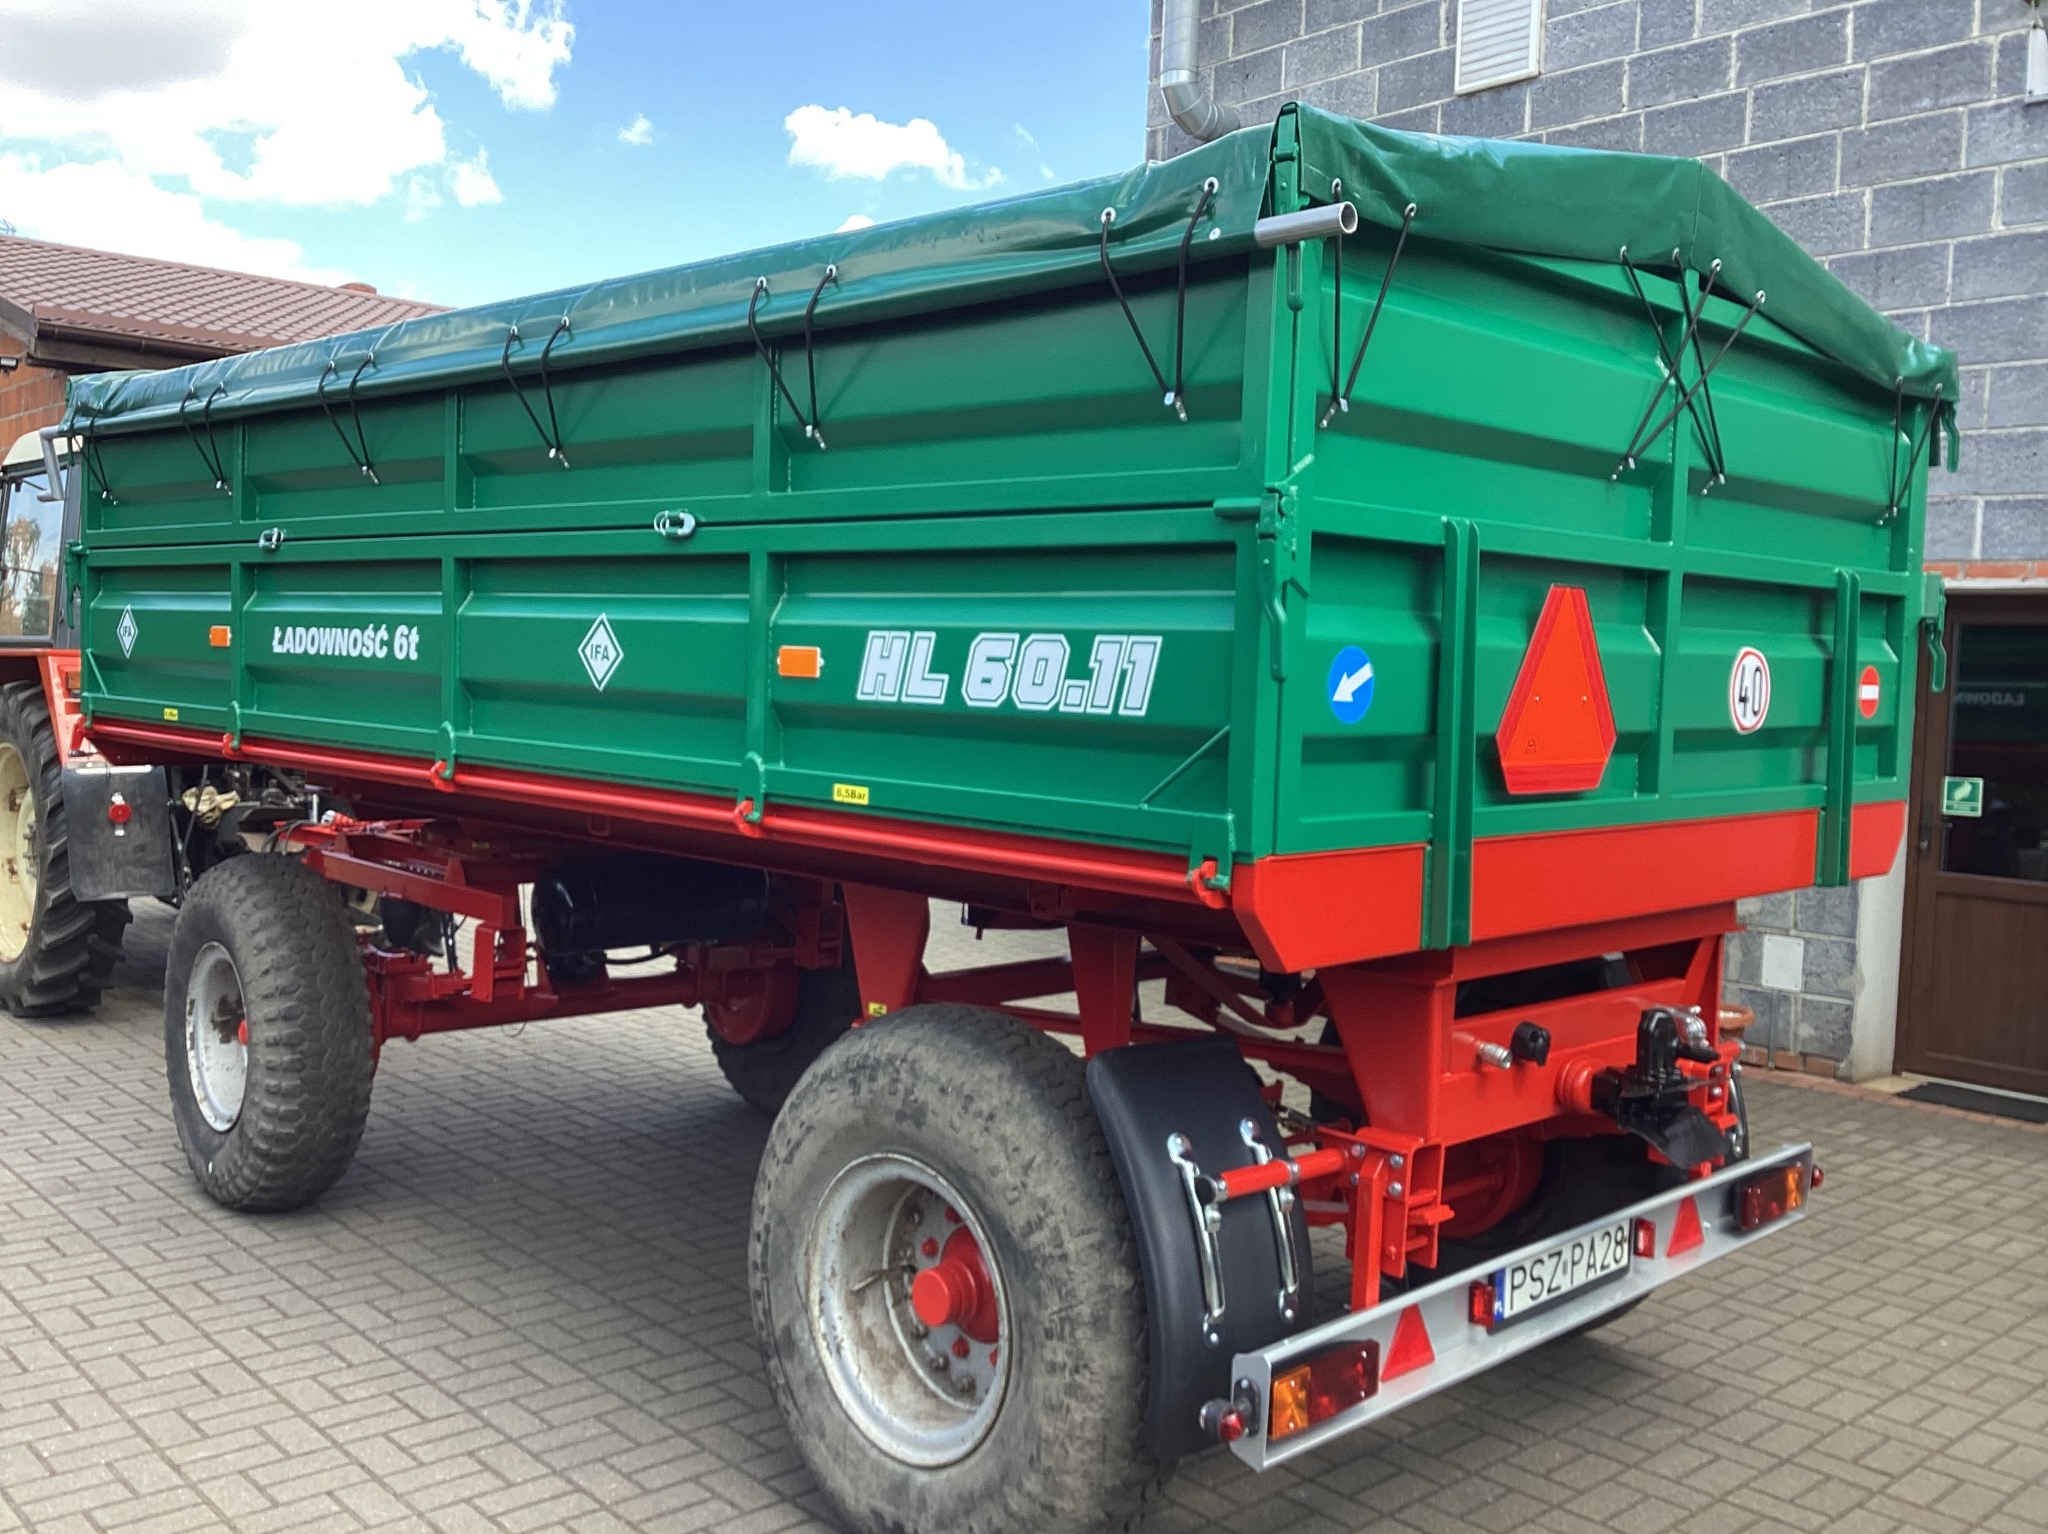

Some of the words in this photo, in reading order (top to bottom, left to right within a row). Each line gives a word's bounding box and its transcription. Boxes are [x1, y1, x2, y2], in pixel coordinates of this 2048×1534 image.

[122, 625, 132, 637] IFA
[272, 623, 389, 659] ŁADOWNOŚĆ
[393, 624, 419, 661] 6t
[590, 643, 610, 662] IFA
[857, 630, 950, 705] HL
[961, 632, 1163, 717] 60.11
[1739, 663, 1763, 719] 40
[1510, 1250, 1563, 1311] PSZ
[1571, 1225, 1625, 1286] PA28
